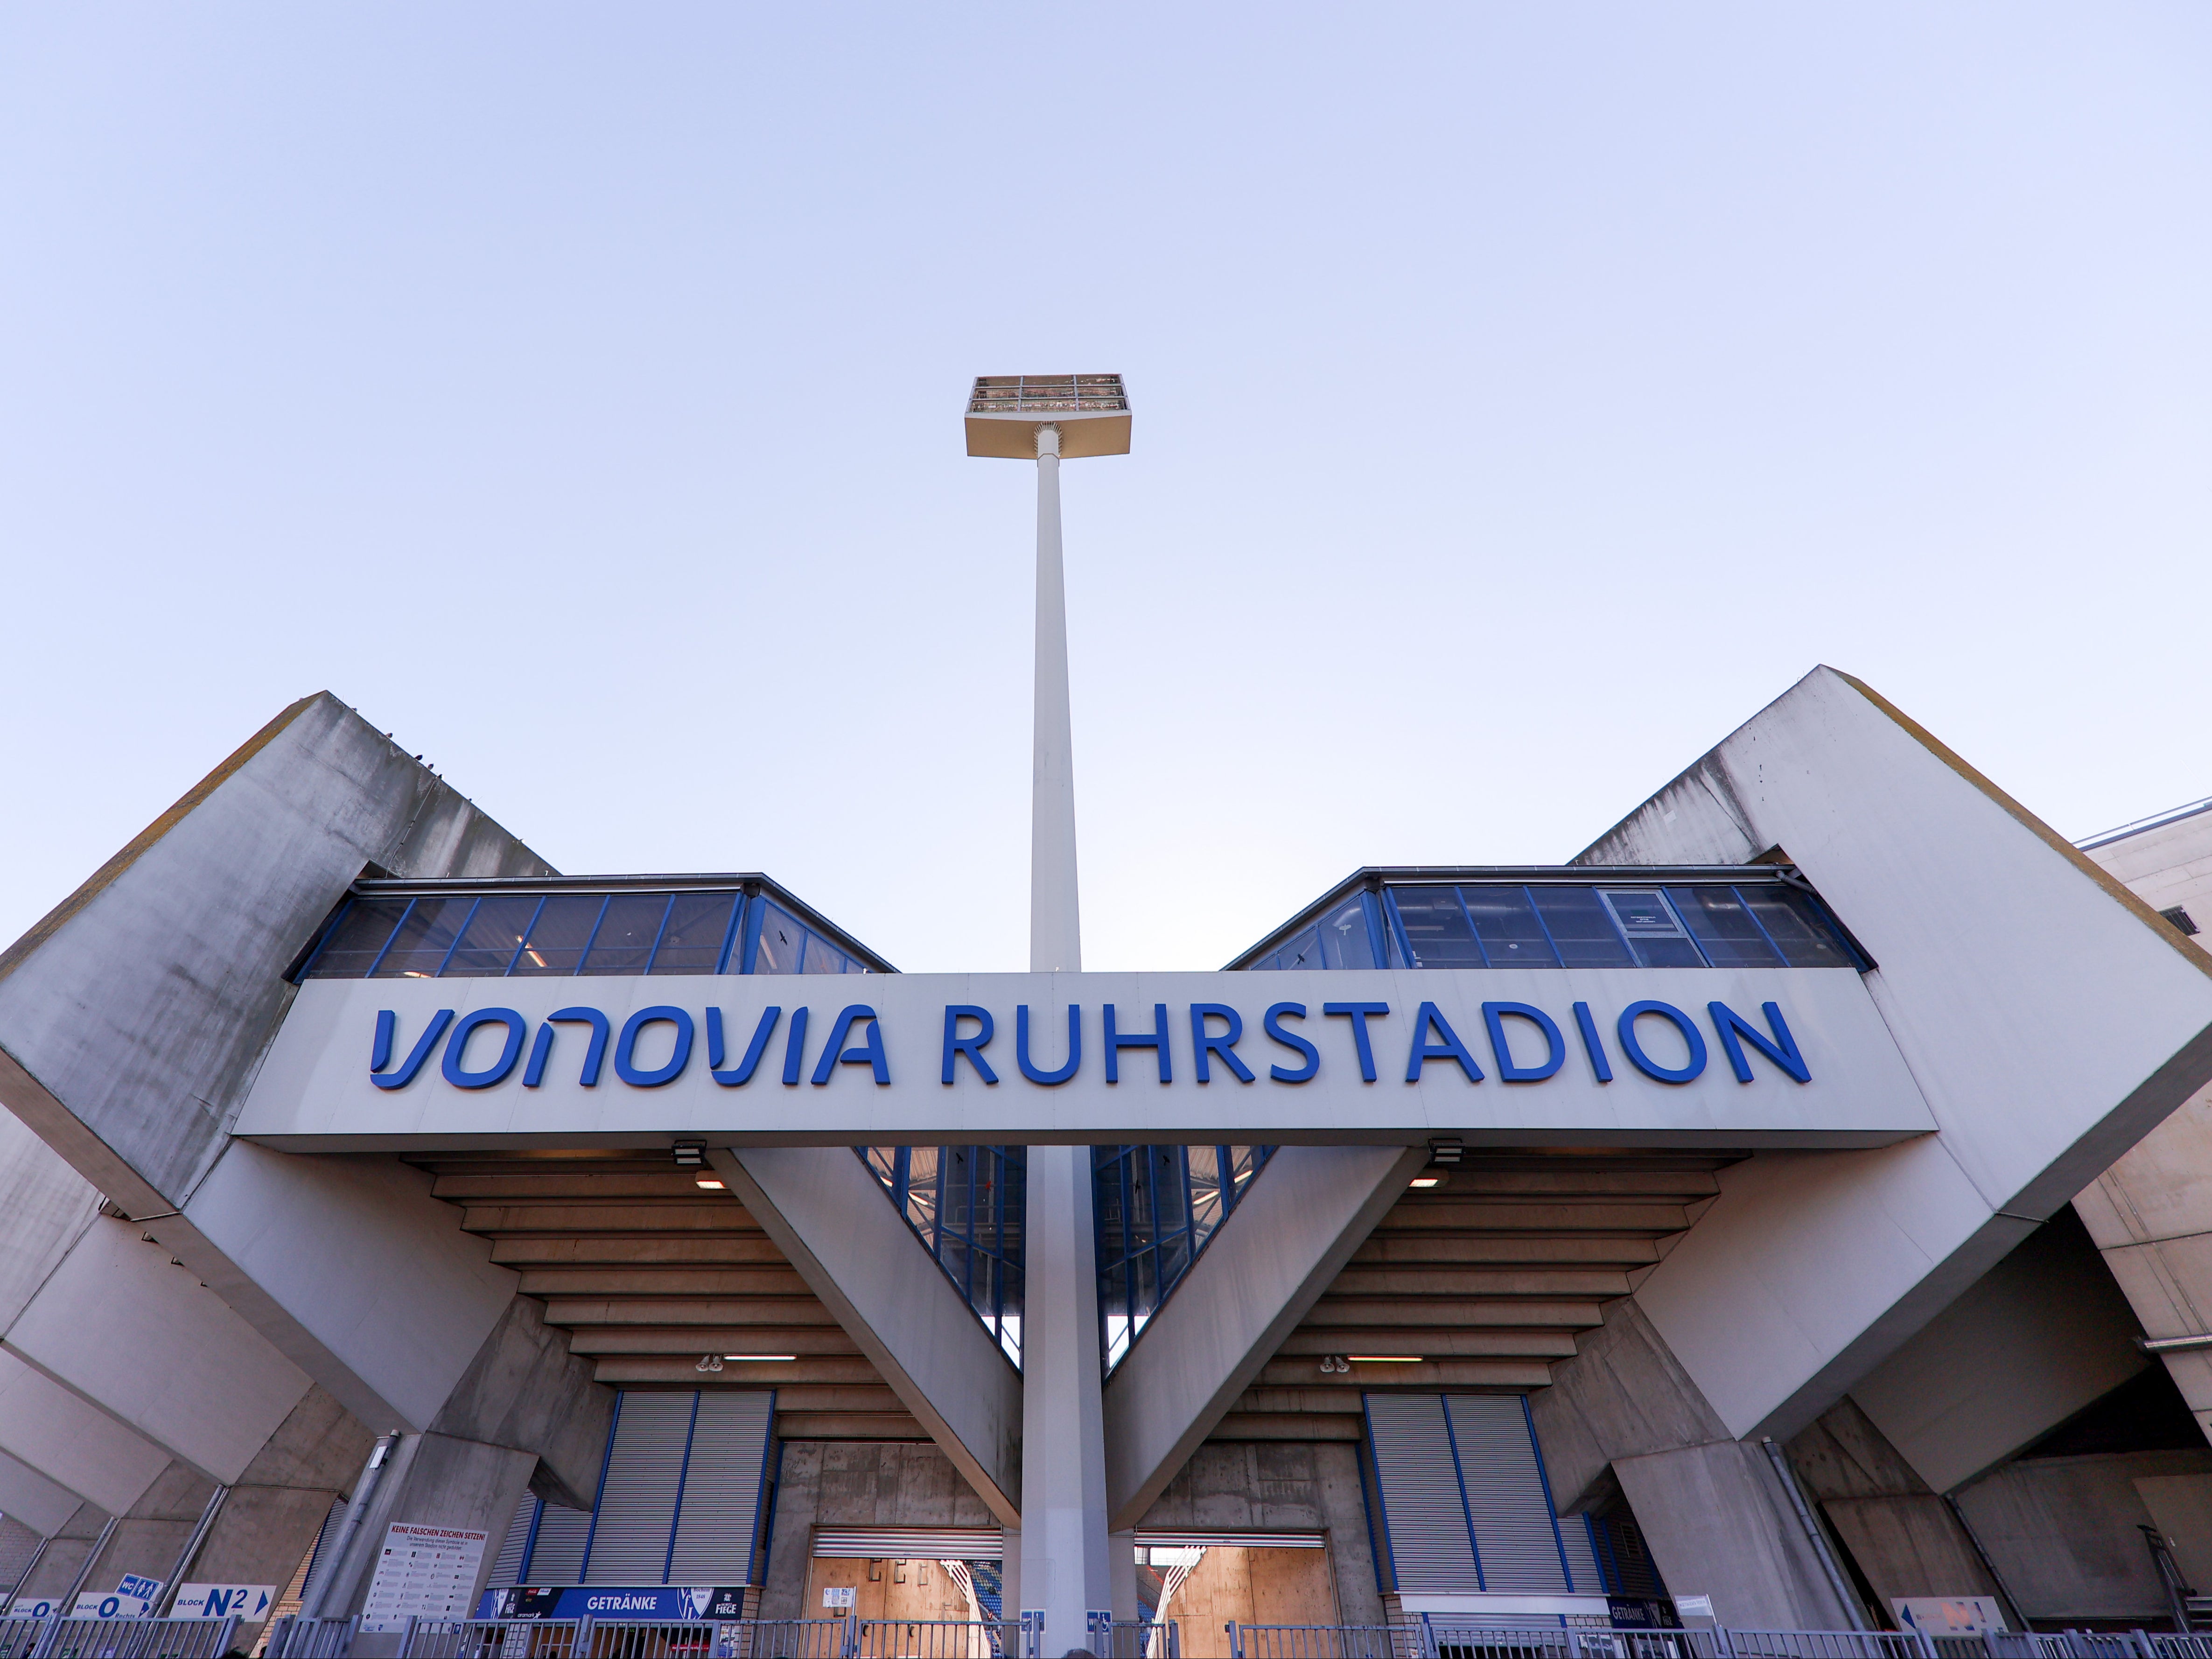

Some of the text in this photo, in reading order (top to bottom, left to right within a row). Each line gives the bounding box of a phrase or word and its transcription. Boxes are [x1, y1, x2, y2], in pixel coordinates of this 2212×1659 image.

[371, 1000, 1812, 1087] VONOVIA RUHRSTADION
[410, 1527, 438, 1537] FALSCHEN
[440, 1530, 463, 1539] ZEICHEN
[122, 1582, 134, 1590] WC
[98, 1597, 119, 1618] O
[587, 1593, 657, 1610] GETRÄNKE
[715, 1604, 737, 1614] FIEGE
[32, 1602, 50, 1617] O
